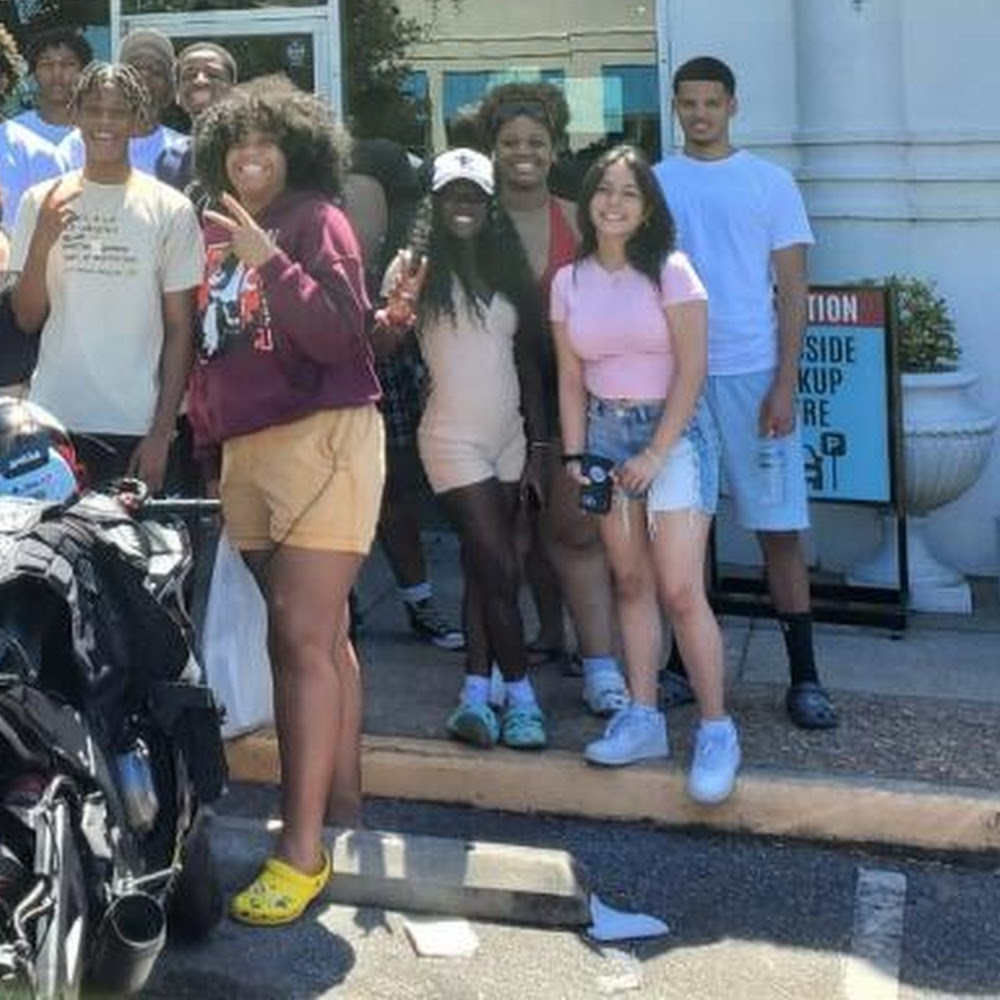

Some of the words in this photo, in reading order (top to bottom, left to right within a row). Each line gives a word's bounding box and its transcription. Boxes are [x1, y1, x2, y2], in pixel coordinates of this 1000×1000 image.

[806, 293, 858, 323] TION
[802, 335, 855, 364] SIDE
[798, 368, 843, 395] KUP
[802, 400, 831, 428] RE
